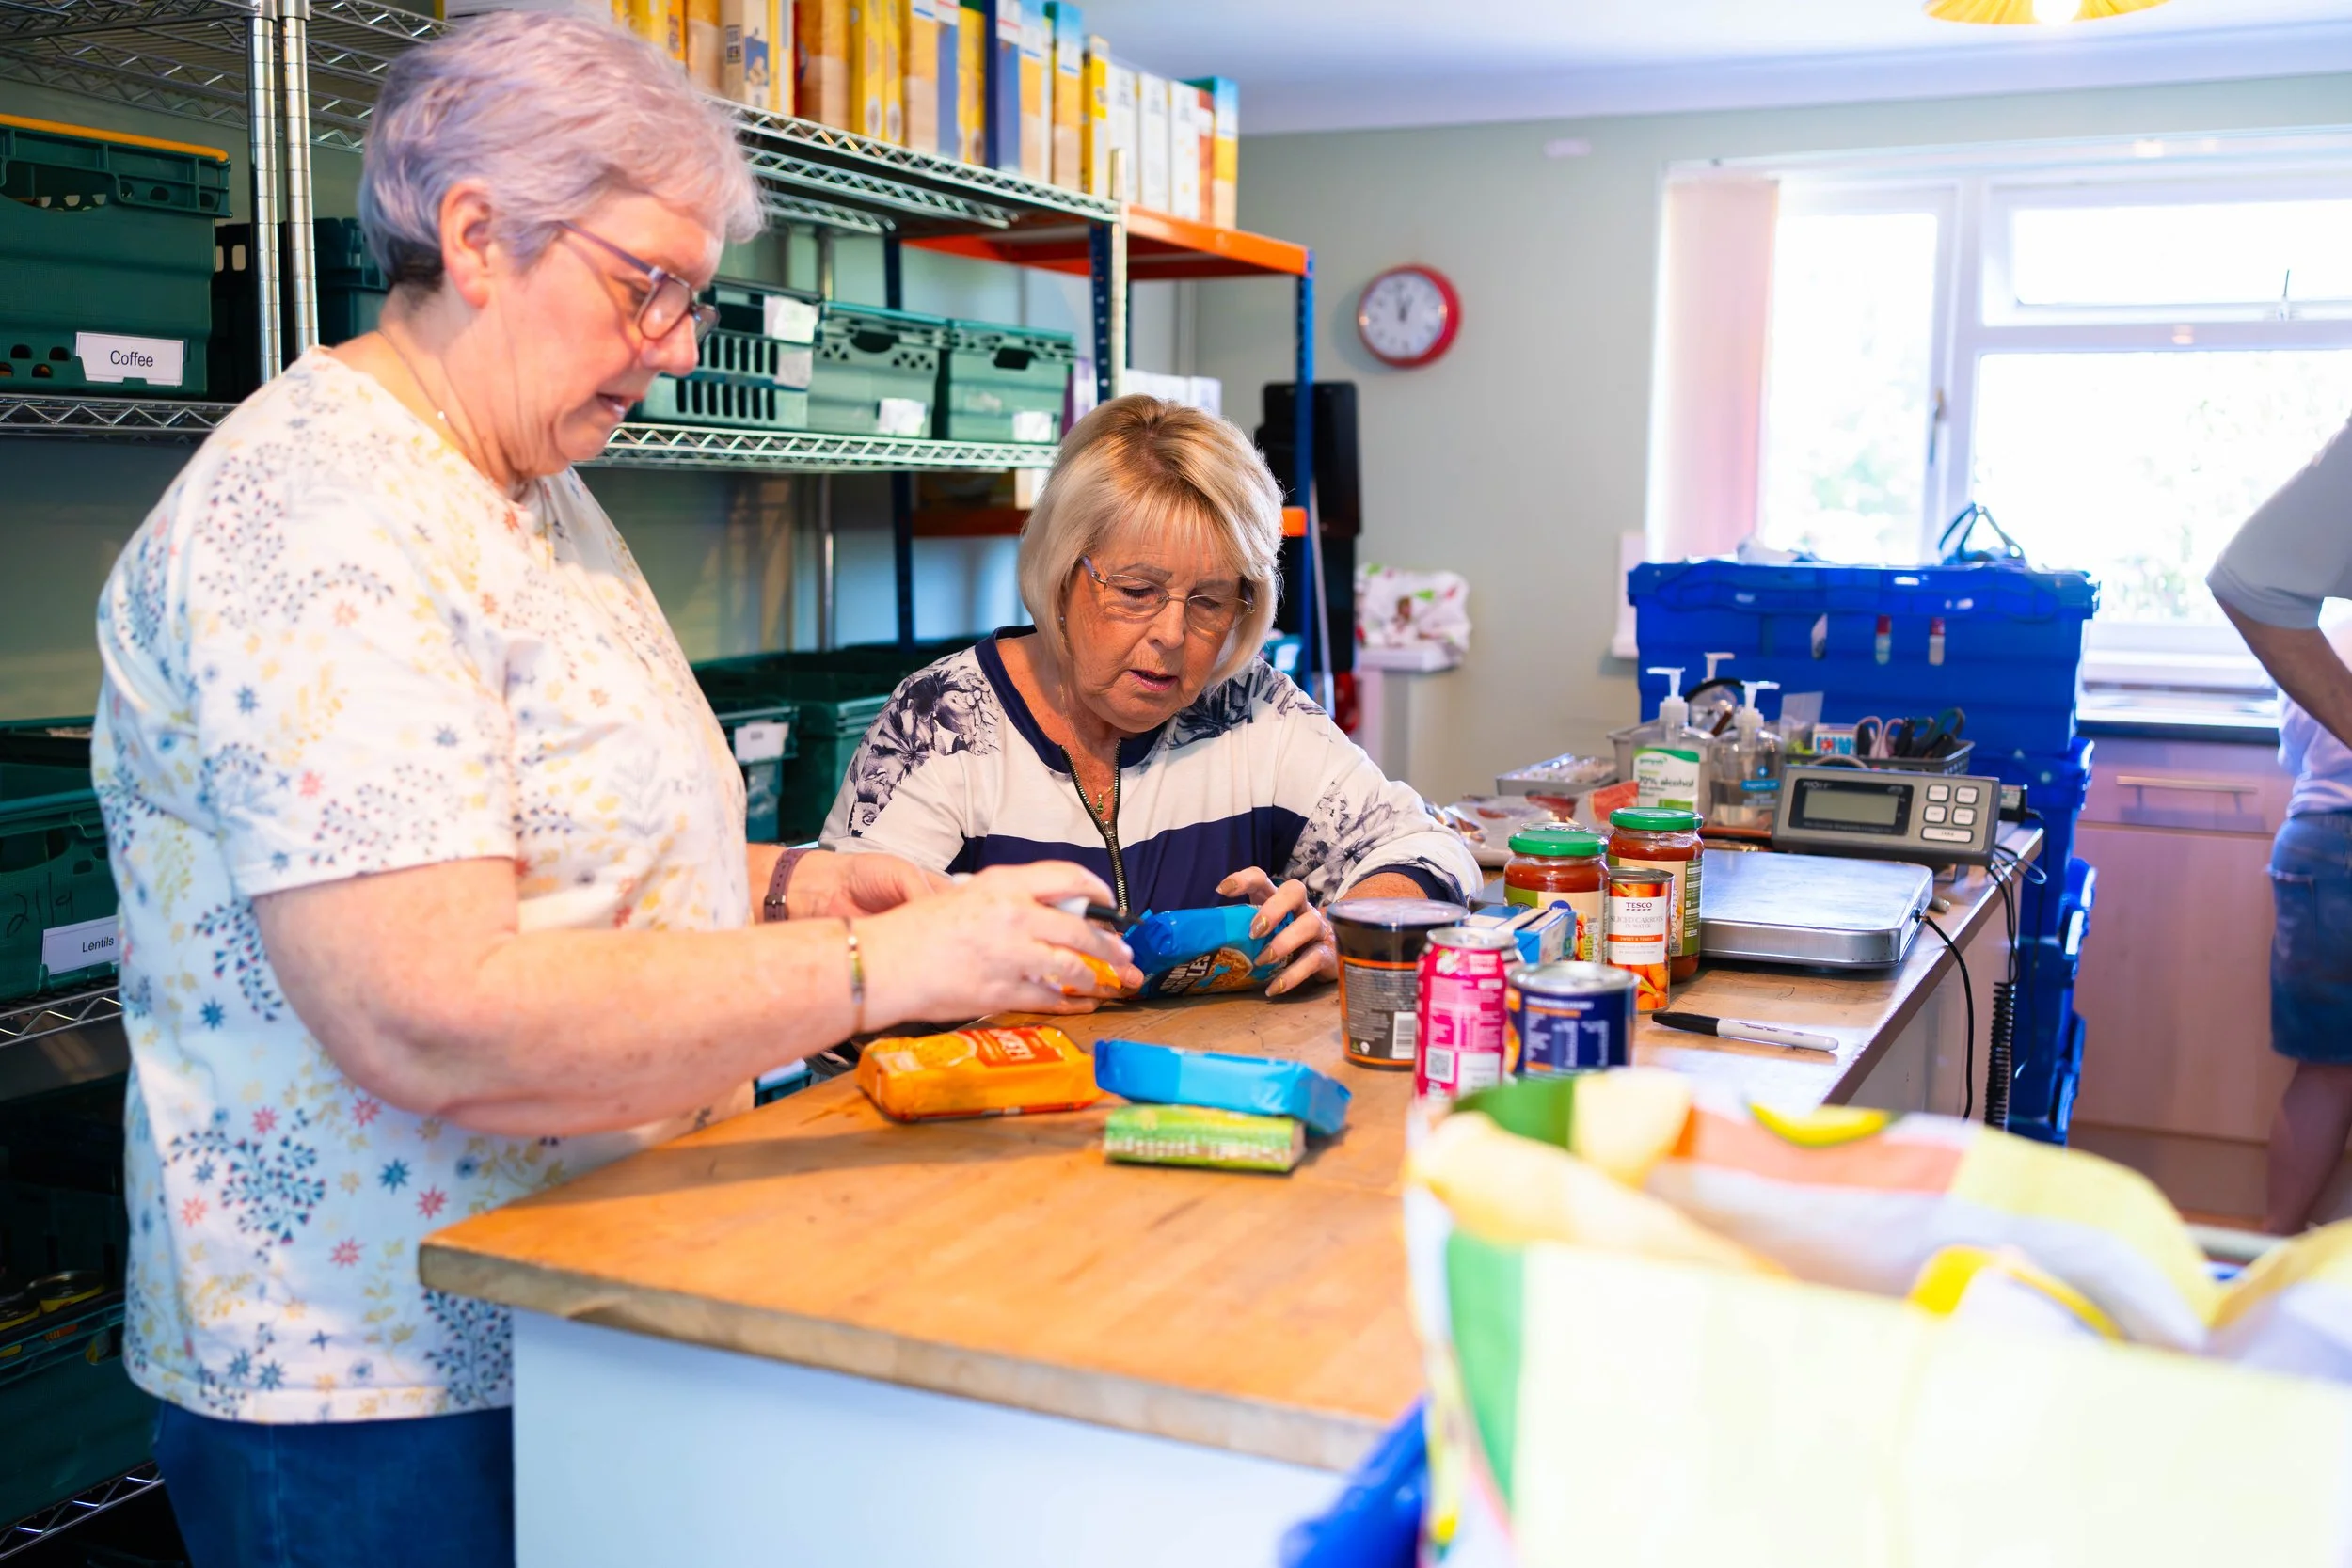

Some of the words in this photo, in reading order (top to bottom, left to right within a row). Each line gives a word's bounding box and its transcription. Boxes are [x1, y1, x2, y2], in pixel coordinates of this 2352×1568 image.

[110, 350, 154, 368] Coffee
[1660, 776, 1694, 787] alcohol
[82, 936, 115, 953] Lentils
